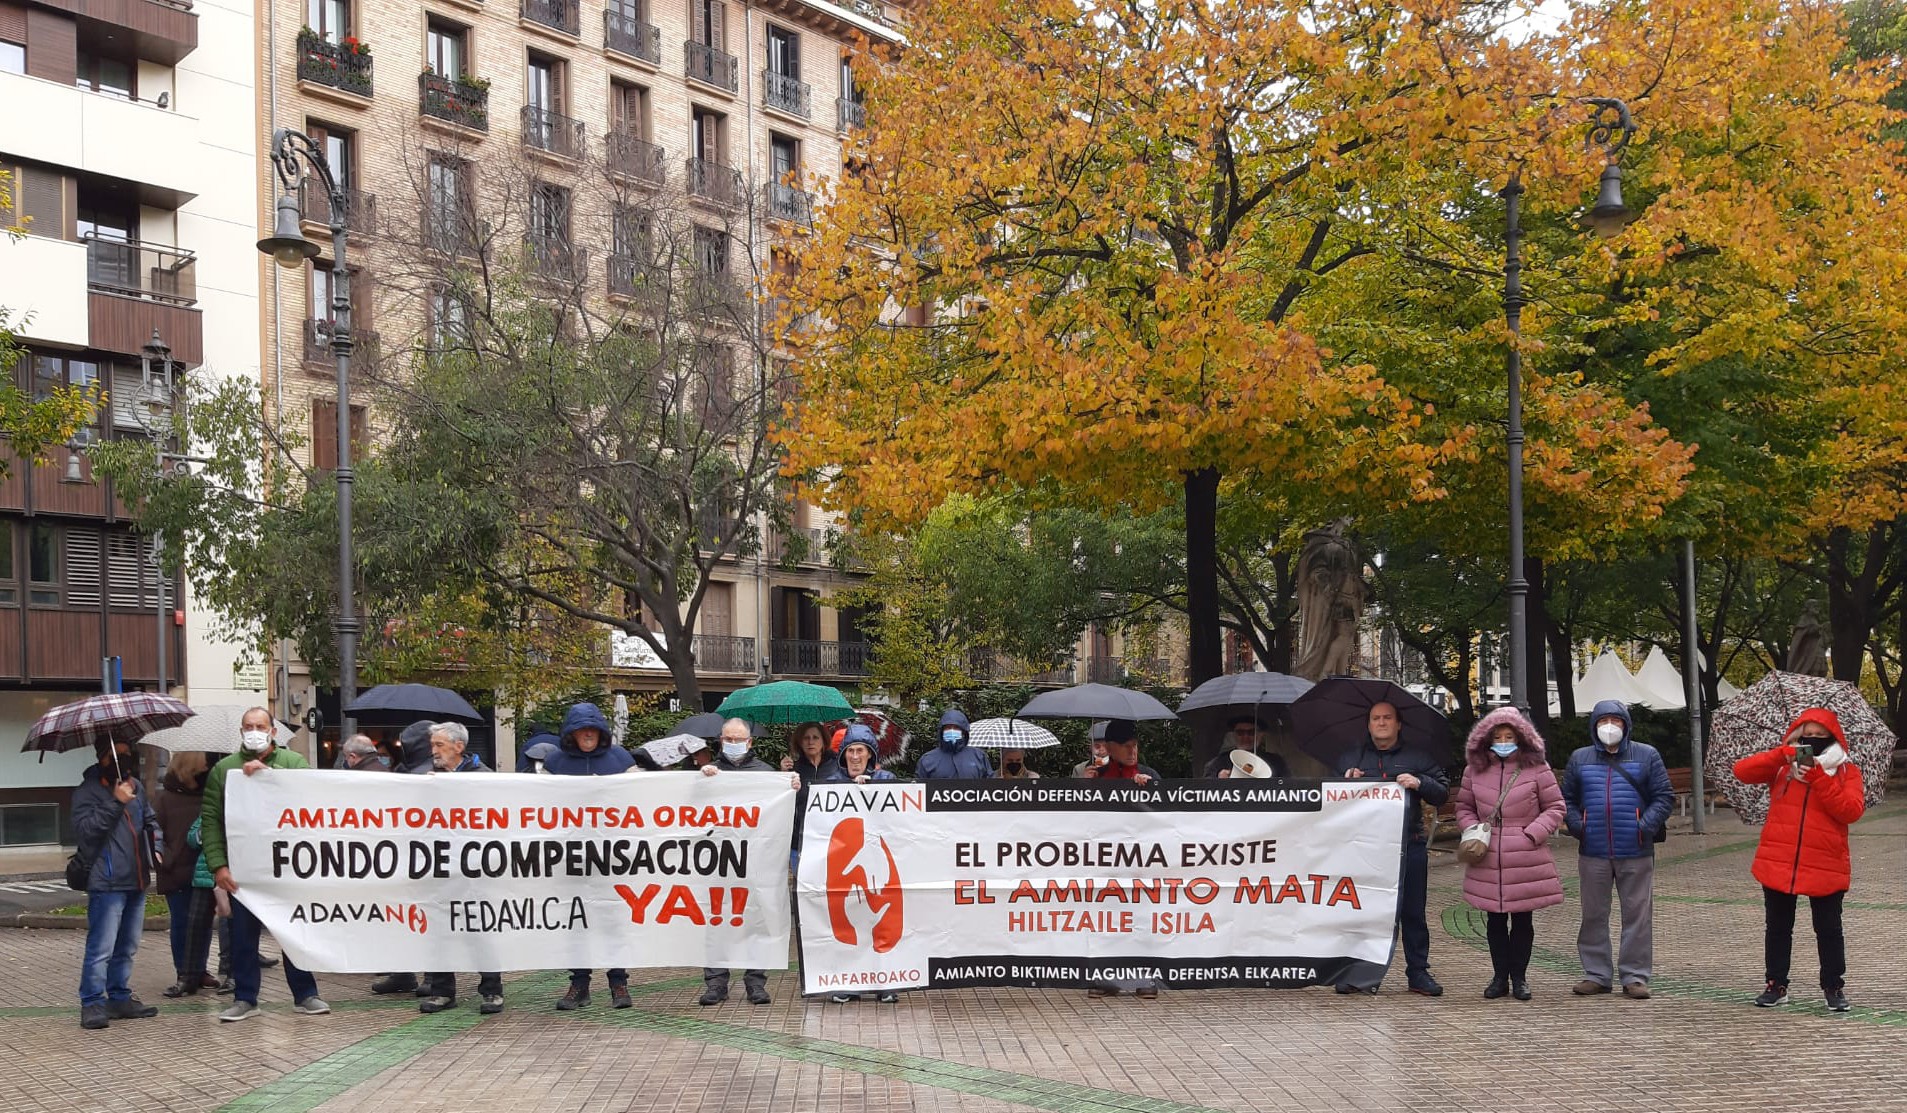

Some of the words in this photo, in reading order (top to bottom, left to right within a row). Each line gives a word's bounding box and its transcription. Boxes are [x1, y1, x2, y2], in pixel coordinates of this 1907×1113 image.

[807, 789, 922, 813] ADAVAN
[931, 785, 1033, 803] ASOCIACIÓN
[1037, 789, 1104, 802] DEFENSA
[1108, 789, 1162, 803] AYUDA
[1166, 786, 1241, 803] VÍCTIMAS
[1245, 789, 1321, 803] AMIANTO
[1326, 786, 1402, 801] NAVARRA
[277, 806, 510, 830] AMIANTOAREN
[519, 805, 645, 829] FUNTSA
[652, 805, 761, 829] ORAIN
[272, 839, 399, 880] FONDO
[408, 840, 451, 880] DE
[460, 830, 748, 879] COMPENSACIÓN
[955, 842, 986, 867] EL
[997, 841, 1169, 868] PROBLEMA
[1181, 839, 1277, 868] EXISTE
[954, 879, 996, 905] EL
[1008, 877, 1220, 905] AMIANTO
[1233, 873, 1362, 910] MATA
[290, 902, 405, 924] ADAVAN
[613, 883, 750, 928] YA!!
[1008, 910, 1133, 933] HILTZAILE
[1151, 912, 1216, 935] ISILA
[818, 969, 921, 987] NAFARROAKO
[934, 965, 1006, 980] AMIANTO
[1011, 965, 1080, 980] BIKTIMEN
[1085, 966, 1164, 981] LAGUNTZA
[1168, 966, 1240, 981] DEFENTSA
[1244, 966, 1317, 980] ELKARTEA
